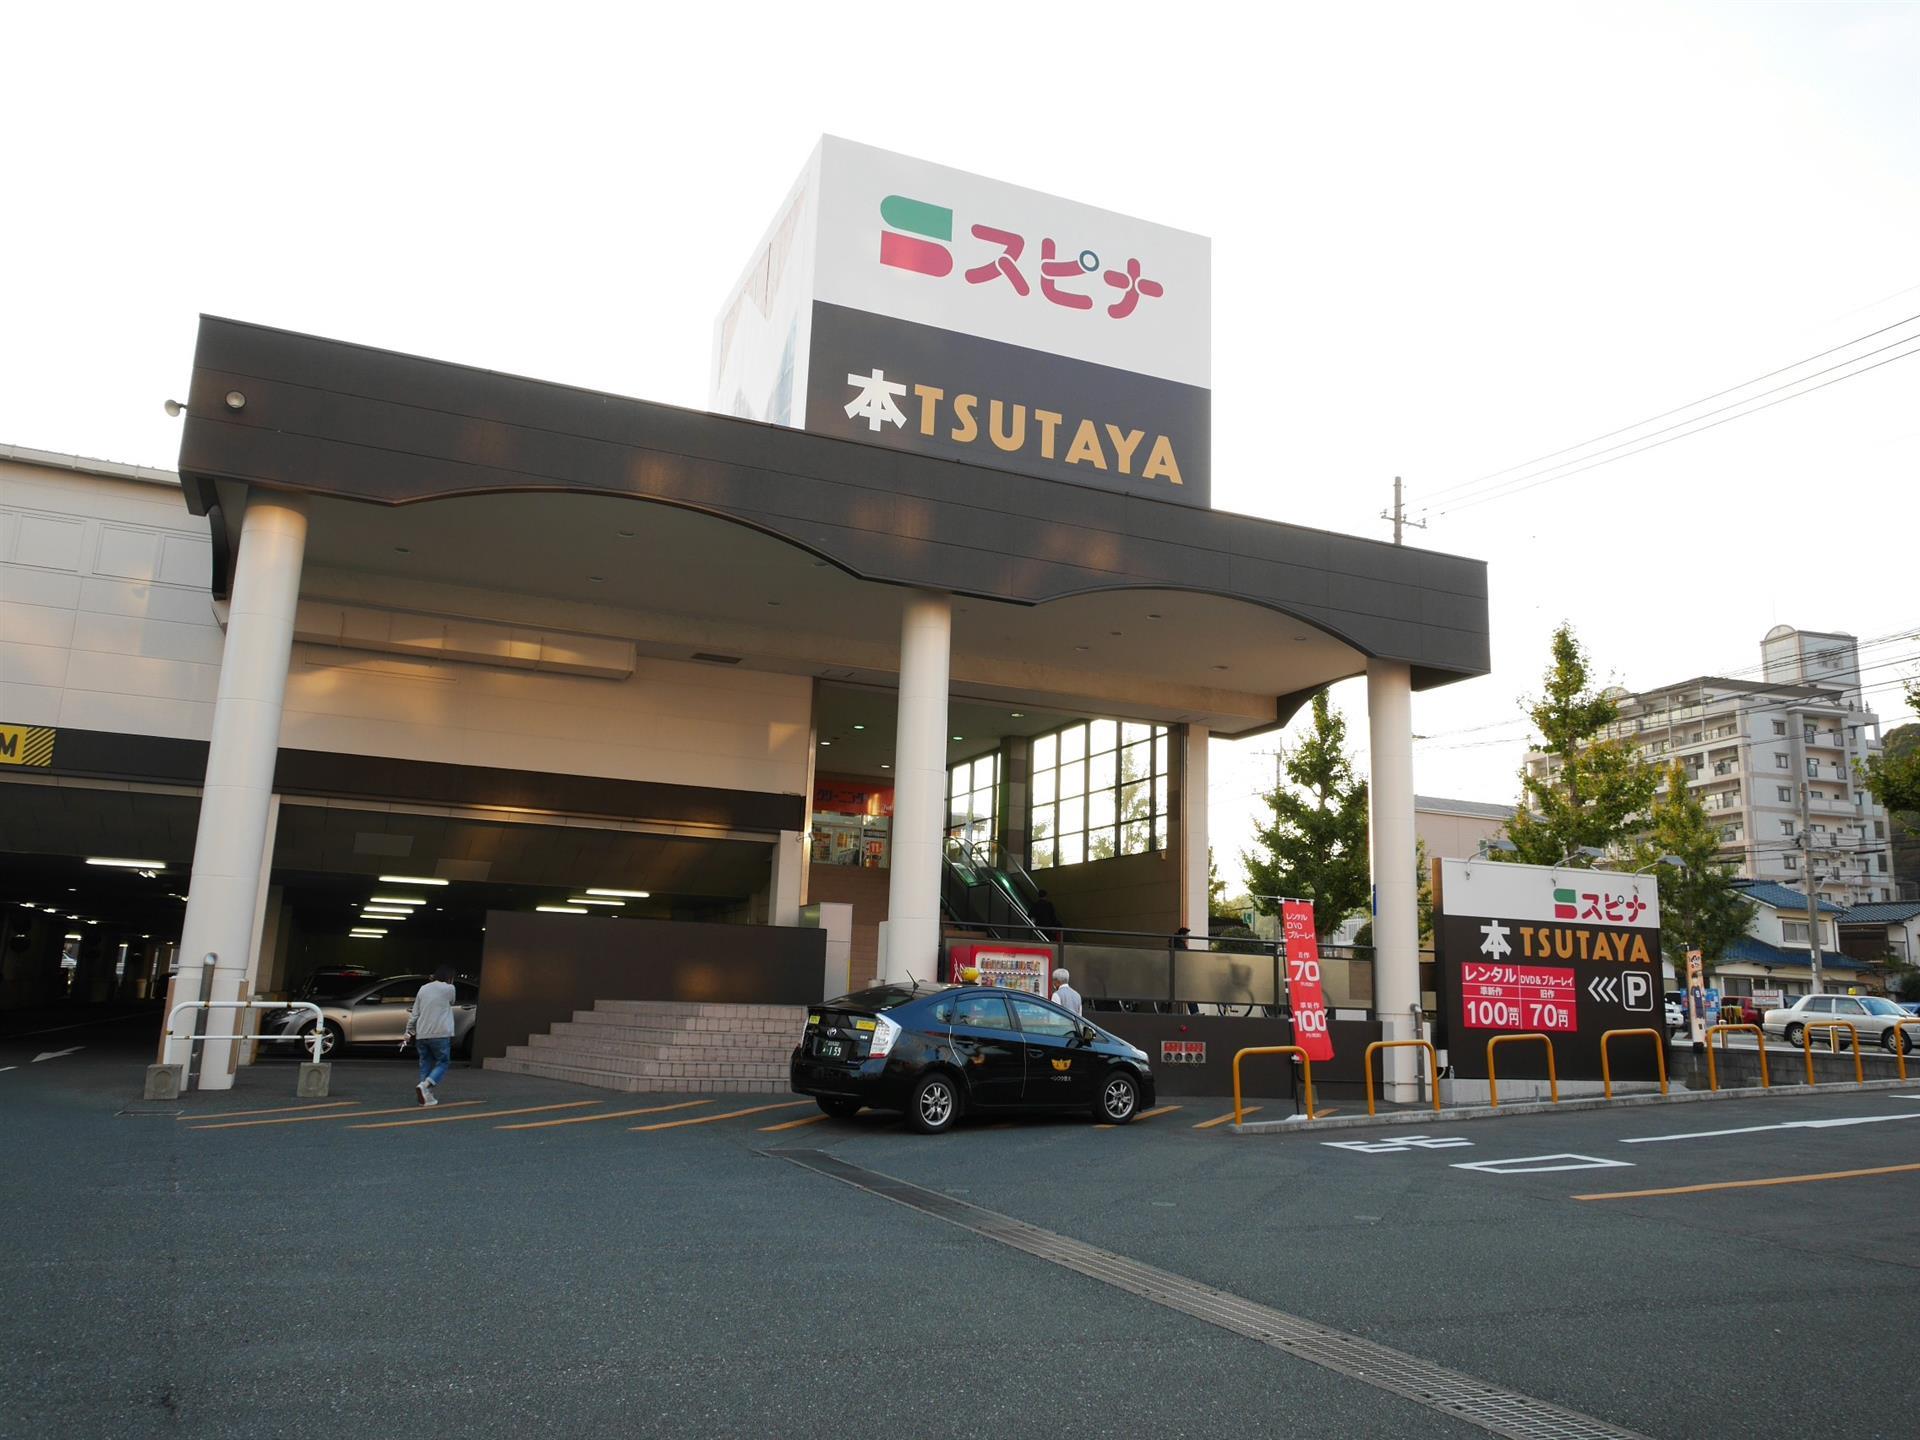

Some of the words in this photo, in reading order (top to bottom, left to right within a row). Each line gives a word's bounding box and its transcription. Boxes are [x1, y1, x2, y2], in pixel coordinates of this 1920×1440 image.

[964, 222, 1164, 320] スピナ
[843, 367, 908, 432] 本
[913, 383, 1184, 485] TSUTAYA
[1581, 893, 1647, 923] スピナ
[1480, 919, 1512, 960] 本
[1519, 926, 1651, 963] TSUTAYA
[1290, 960, 1320, 982] 70
[1465, 965, 1517, 983] レンタル
[1627, 976, 1647, 1006] P
[1294, 1009, 1327, 1032] 100
